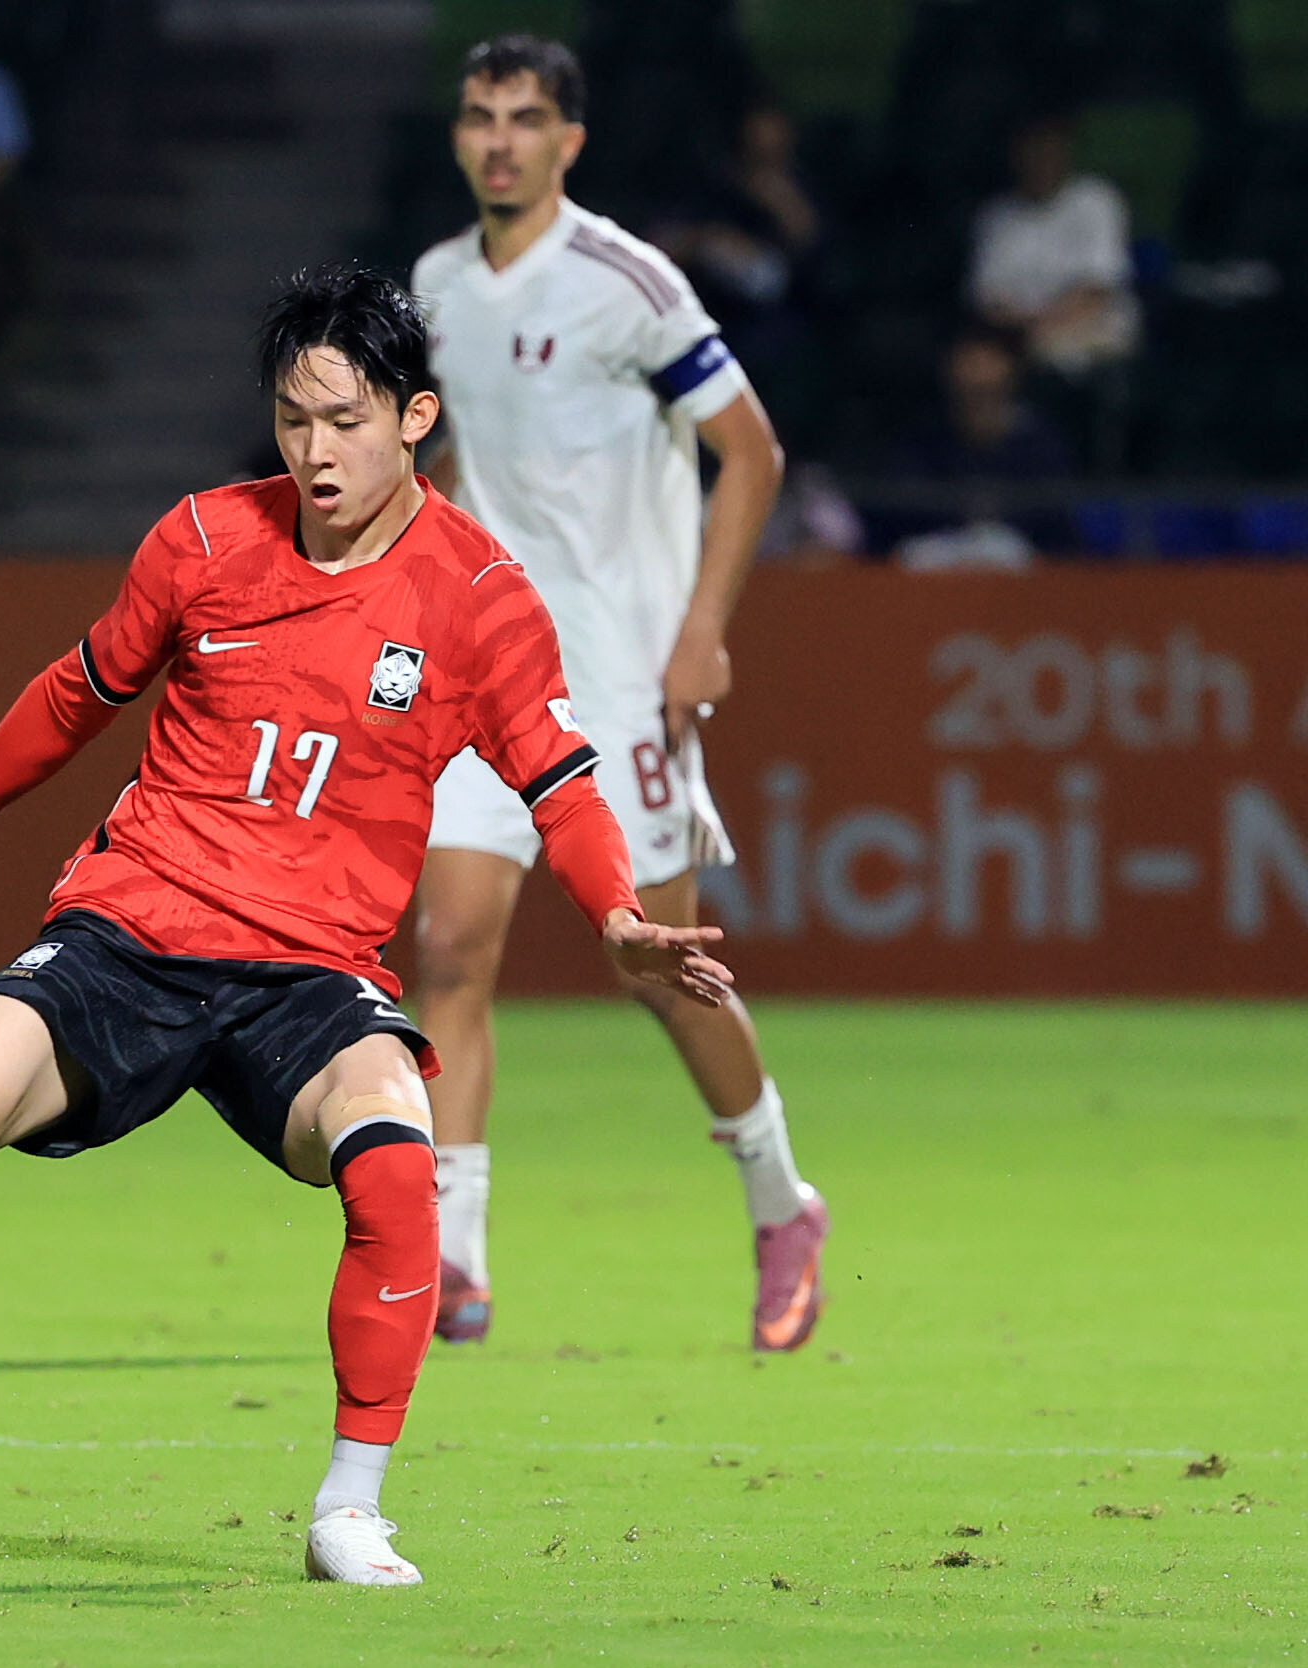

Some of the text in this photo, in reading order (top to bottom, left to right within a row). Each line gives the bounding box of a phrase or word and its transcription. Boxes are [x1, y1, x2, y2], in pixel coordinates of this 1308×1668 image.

[361, 711, 405, 727] KORE
[929, 627, 1250, 750] 20th
[245, 719, 339, 820] 17
[632, 742, 672, 811] 8
